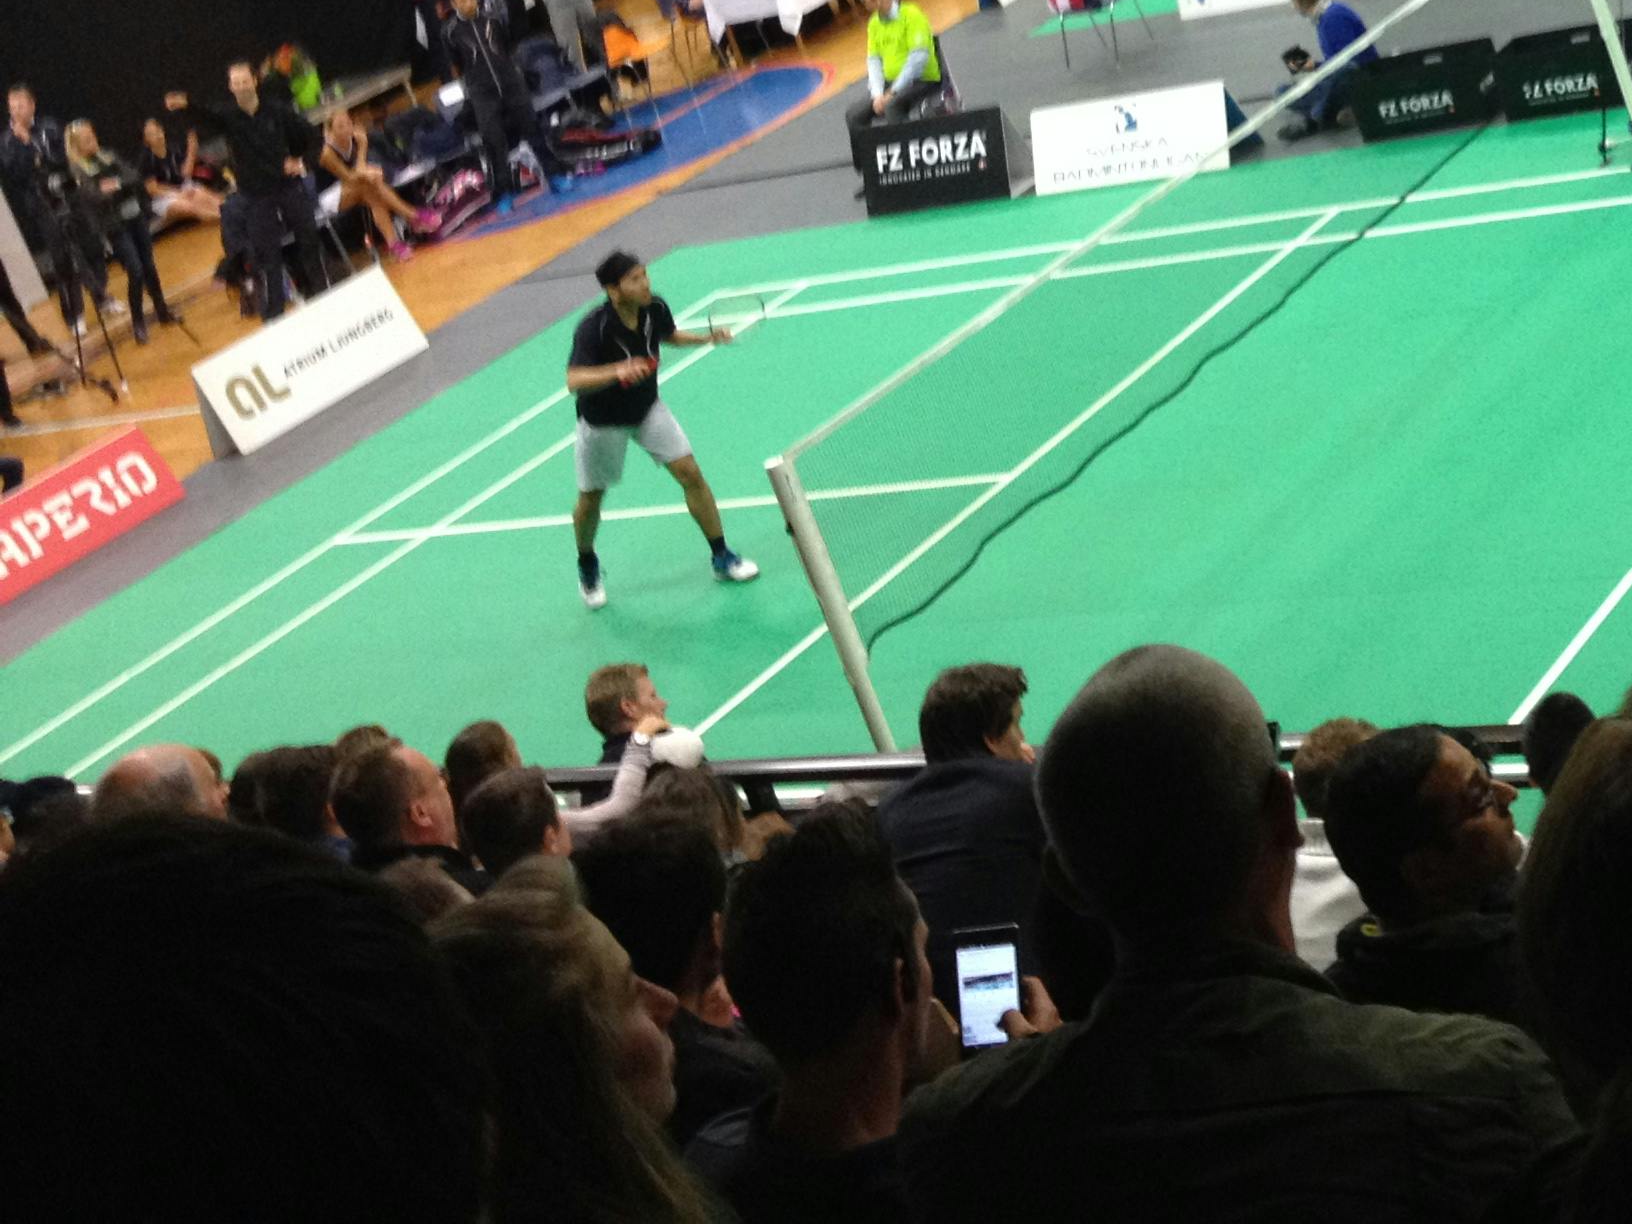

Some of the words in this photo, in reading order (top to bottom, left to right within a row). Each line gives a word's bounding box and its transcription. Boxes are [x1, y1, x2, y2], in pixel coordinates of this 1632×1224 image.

[1545, 72, 1599, 95] FORZA
[1401, 89, 1454, 115] FORZA
[876, 142, 904, 174] FZ
[908, 128, 988, 169] FORZA
[283, 341, 328, 380] ATRIUM
